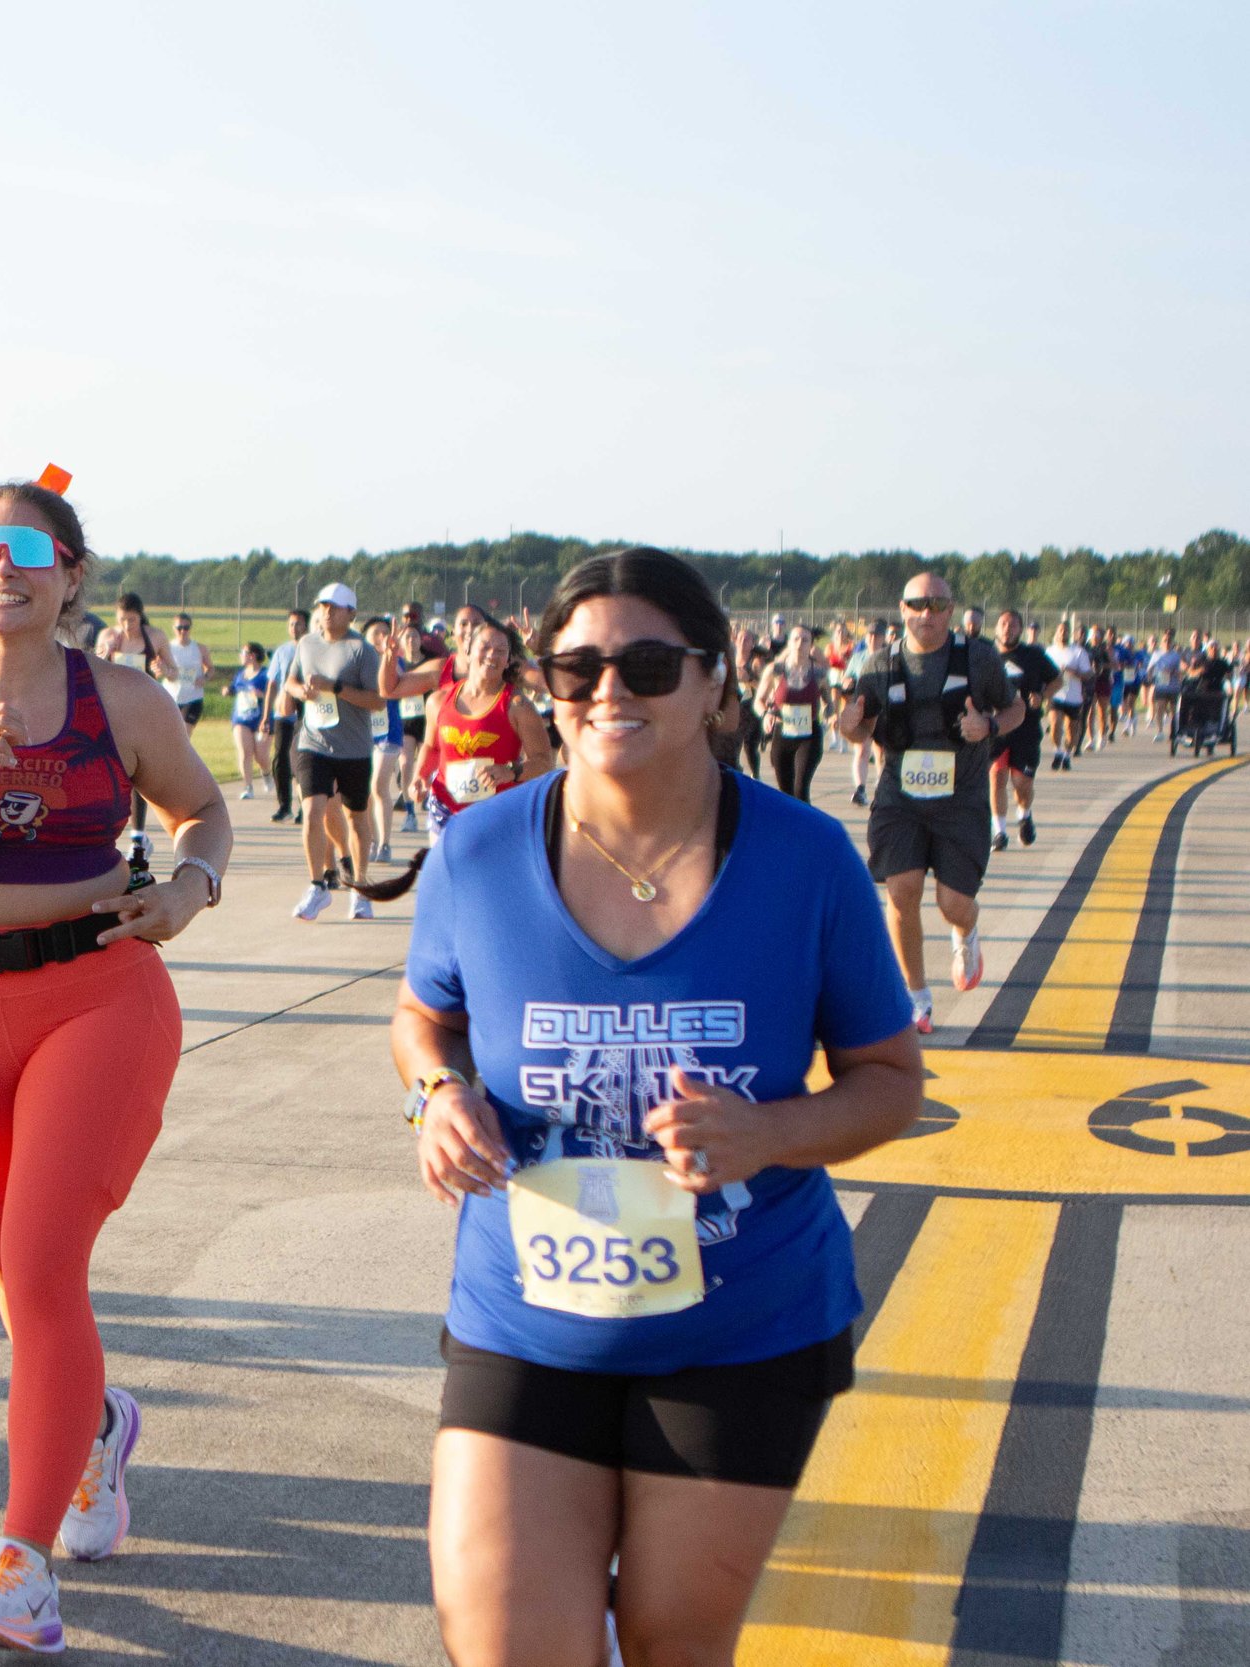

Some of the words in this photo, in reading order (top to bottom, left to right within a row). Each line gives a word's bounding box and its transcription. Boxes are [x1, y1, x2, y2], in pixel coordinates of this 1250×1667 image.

[904, 770, 949, 786] 3688
[524, 1003, 744, 1049] DULLES
[528, 1233, 681, 1287] 3253
